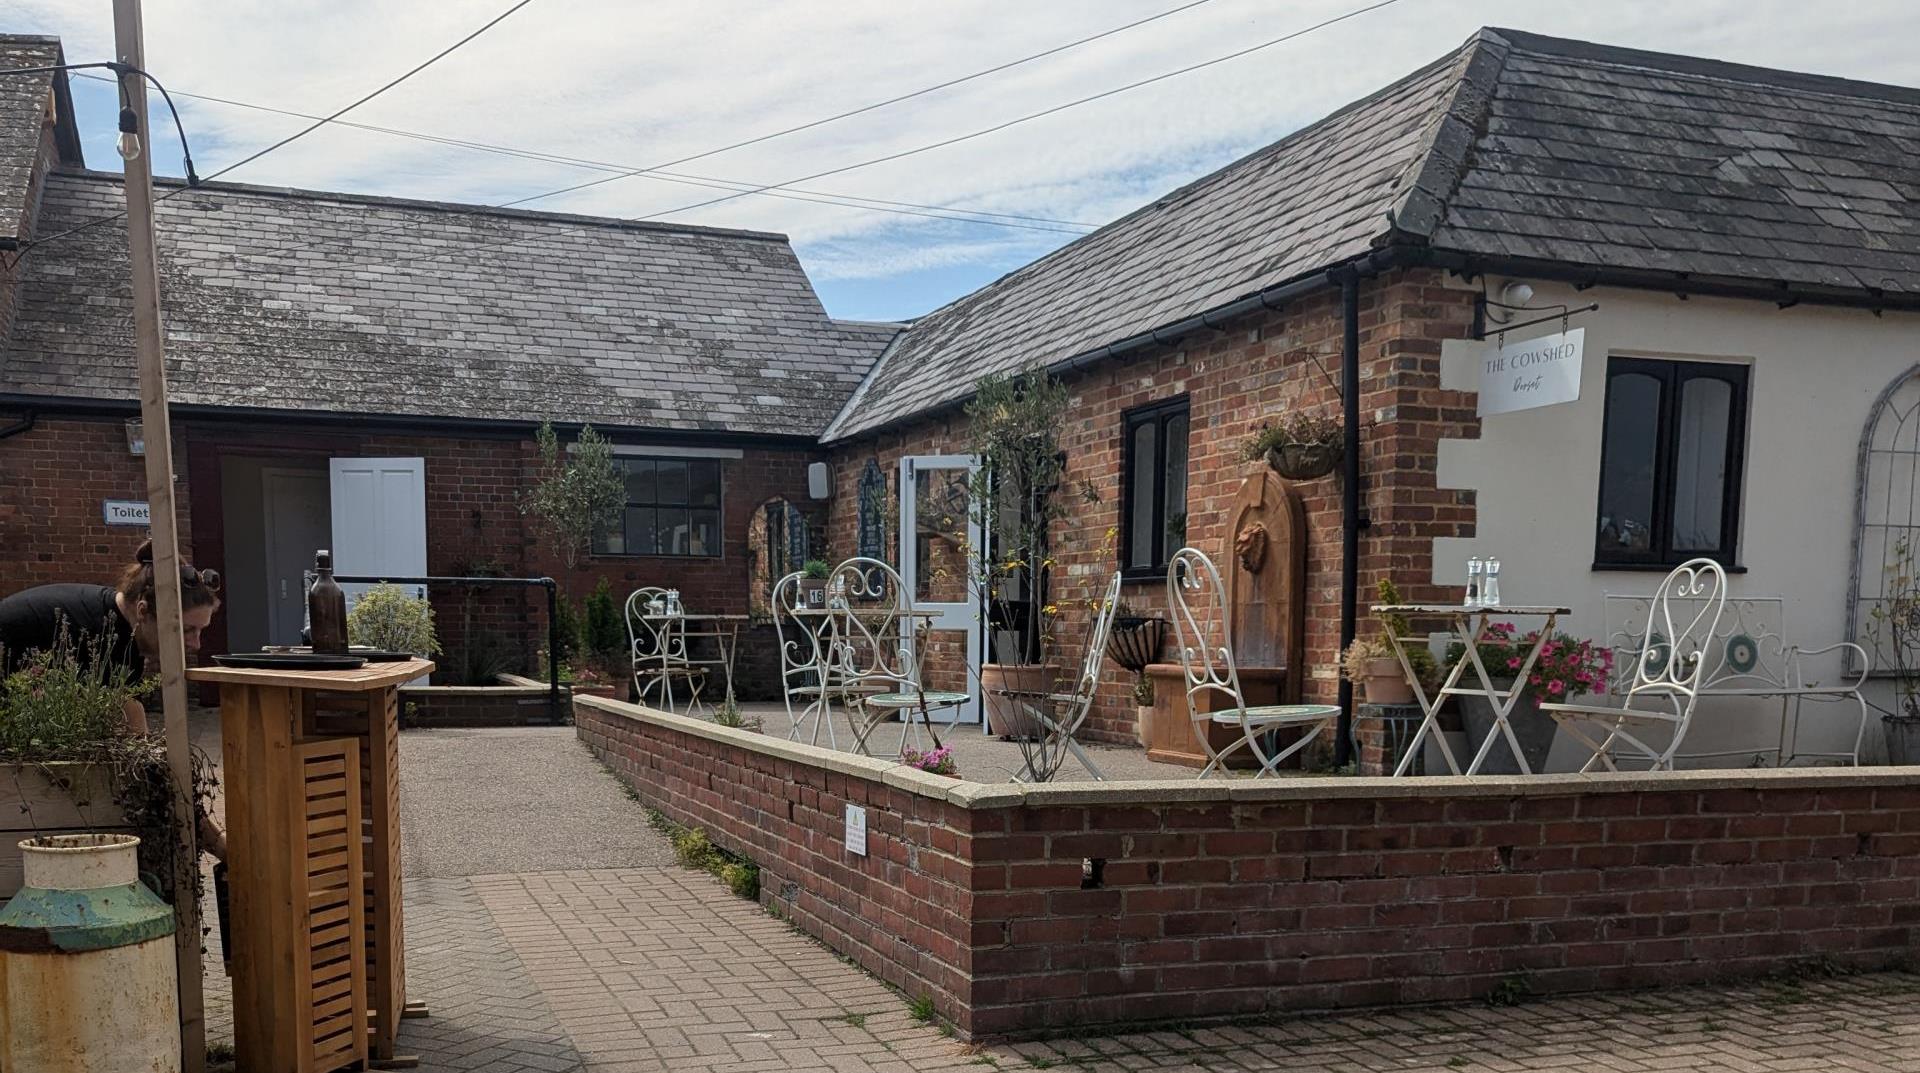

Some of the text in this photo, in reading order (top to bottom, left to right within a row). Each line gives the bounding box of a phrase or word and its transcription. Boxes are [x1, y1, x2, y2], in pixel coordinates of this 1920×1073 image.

[1486, 343, 1575, 374] THE COWSHED
[1512, 376, 1543, 393] Dorset
[811, 590, 823, 602] 16
